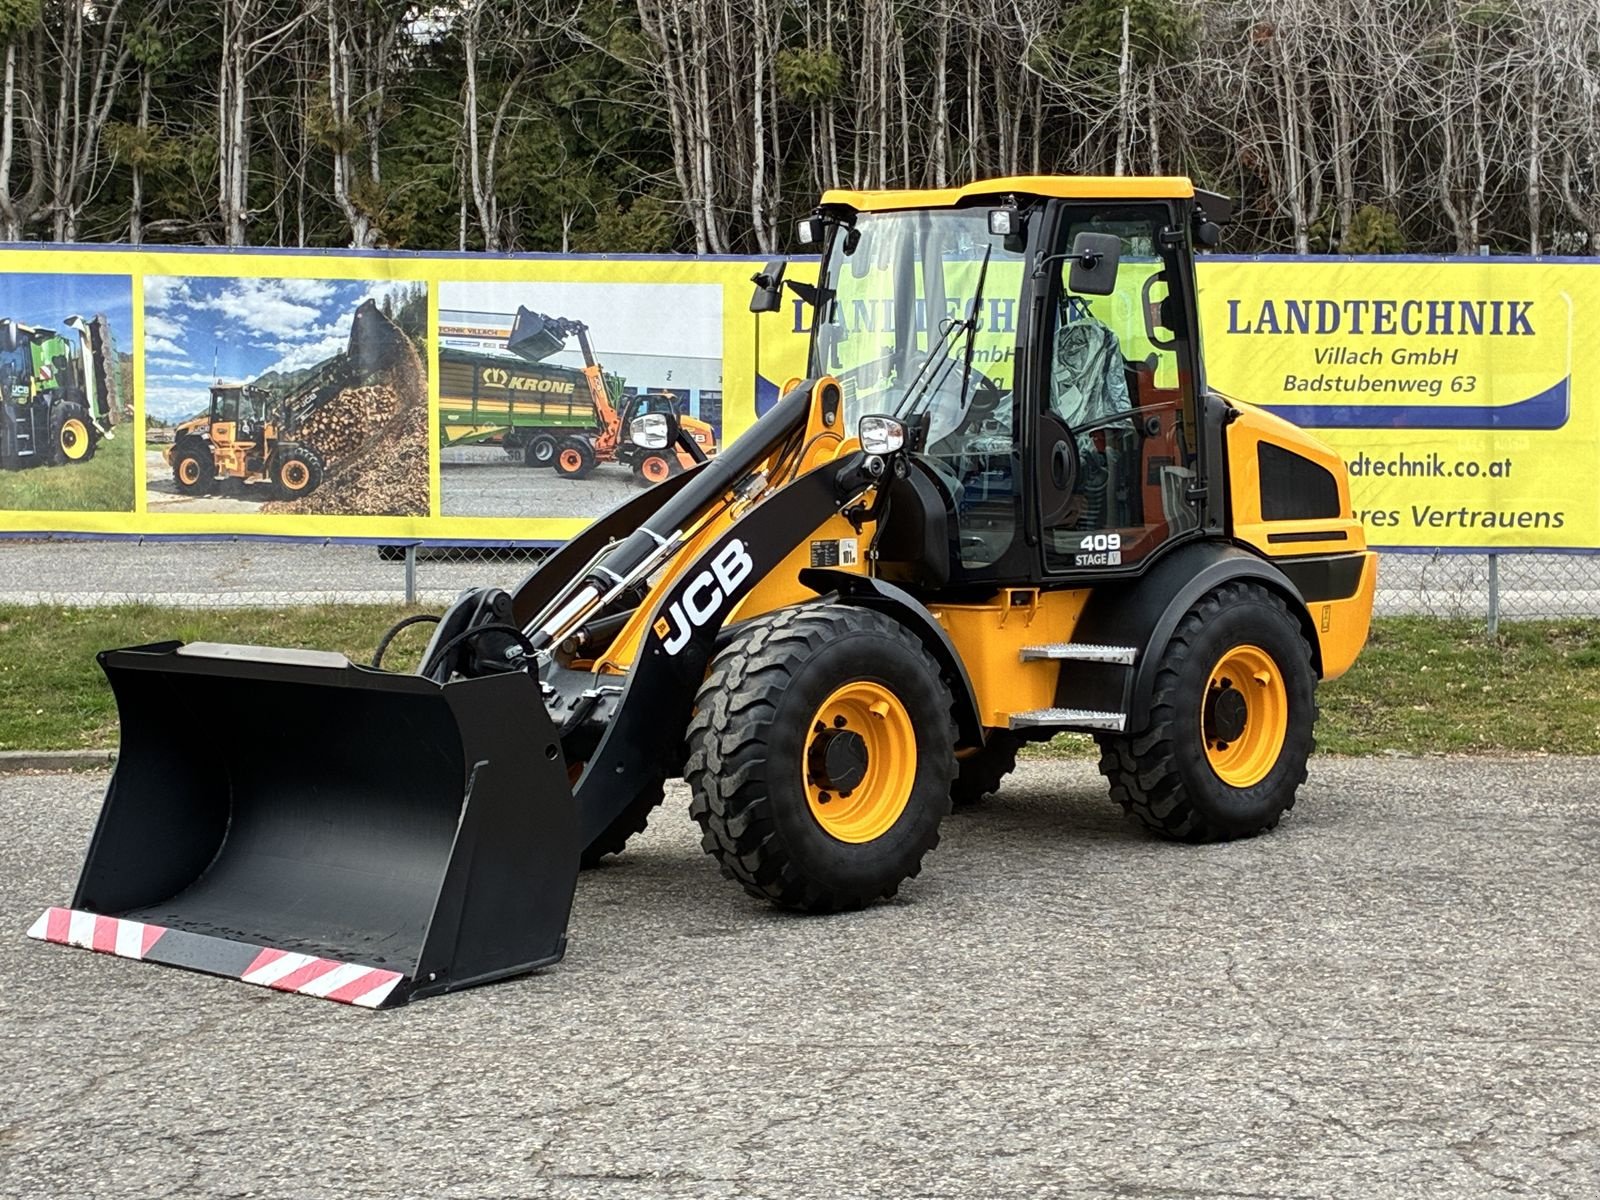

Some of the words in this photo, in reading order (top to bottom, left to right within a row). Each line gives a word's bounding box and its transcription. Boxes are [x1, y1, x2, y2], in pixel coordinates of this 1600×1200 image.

[1226, 300, 1536, 335] LANDTECHNIK
[1314, 347, 1383, 365] Villach
[1391, 348, 1459, 366] GmbH
[508, 376, 575, 394] KRONE
[1283, 374, 1443, 396] Badstubenweg
[1450, 375, 1476, 393] 63
[1411, 505, 1565, 529] Vertrauens
[1080, 533, 1121, 551] 409
[1075, 553, 1107, 566] STAGE
[663, 538, 753, 656] JCB
